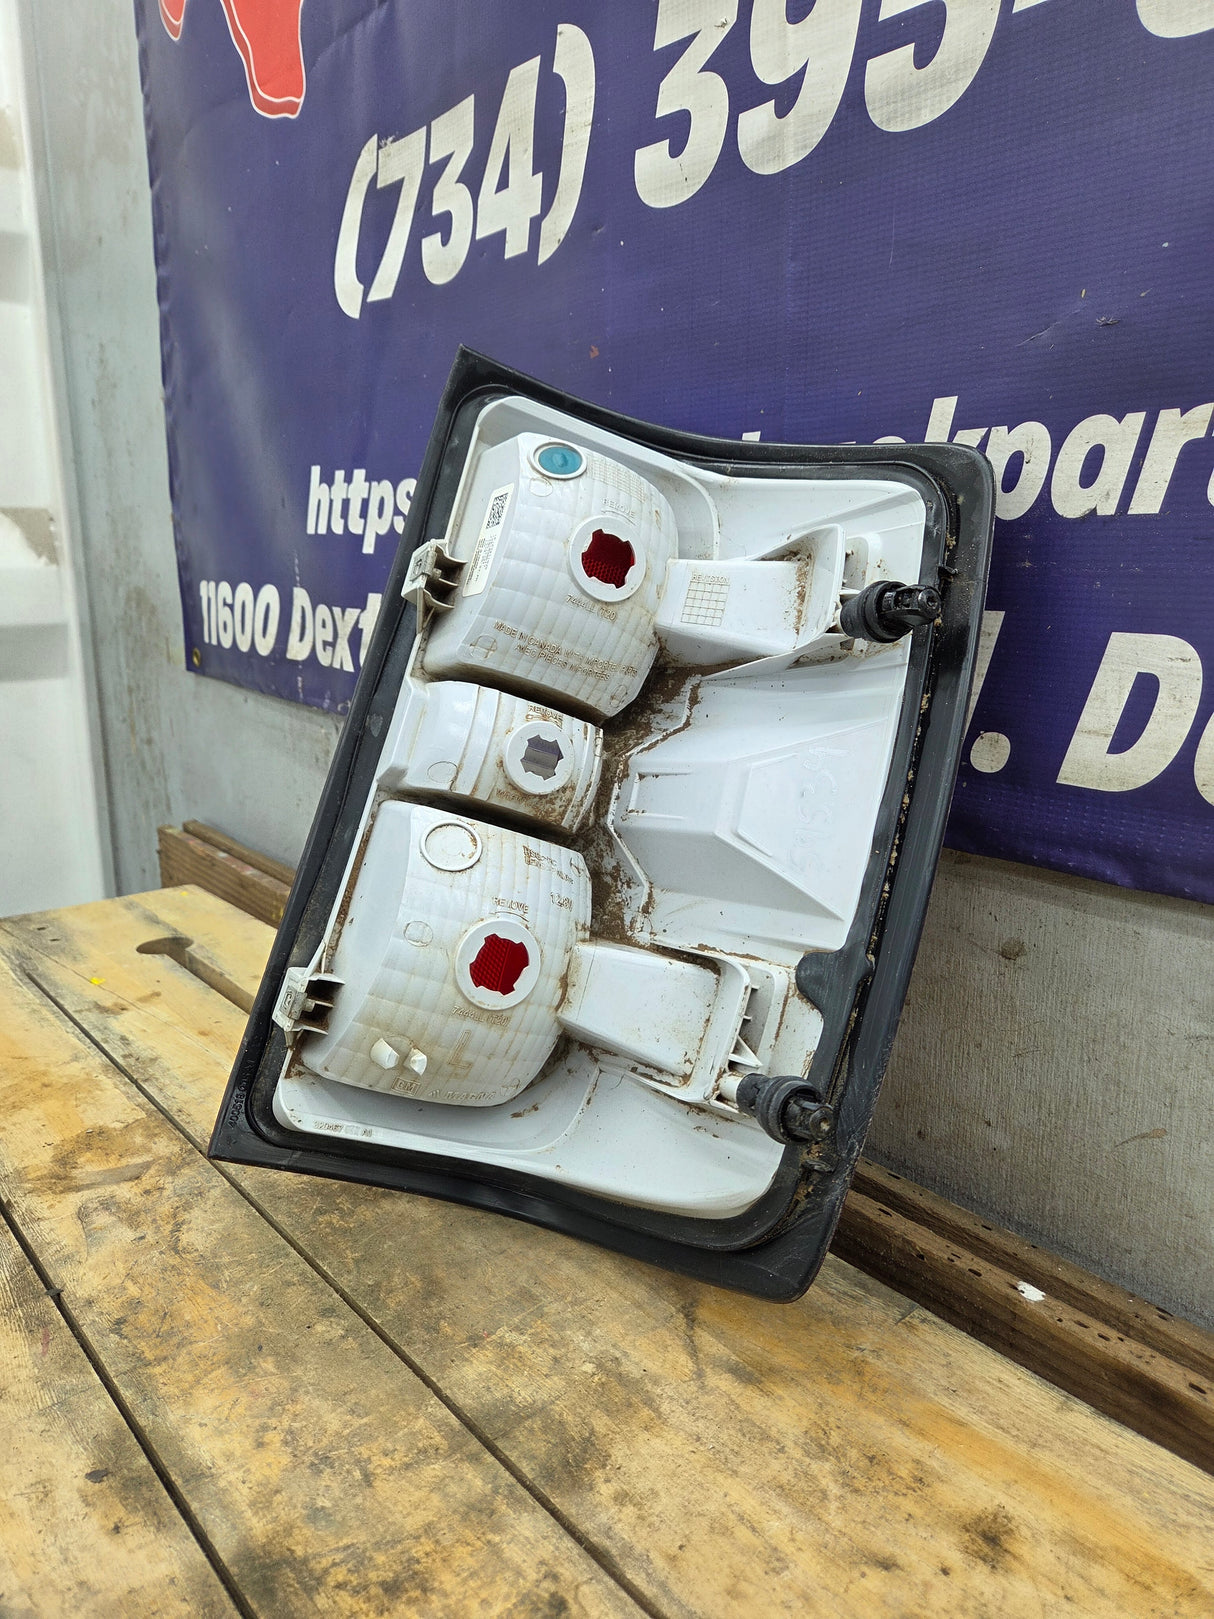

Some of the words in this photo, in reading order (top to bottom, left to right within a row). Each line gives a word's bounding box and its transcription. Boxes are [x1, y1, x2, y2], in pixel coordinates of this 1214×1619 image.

[333, 23, 596, 320] (734)
[199, 579, 280, 657] 11600
[1055, 631, 1214, 807] D
[494, 621, 518, 639] MADE
[527, 636, 561, 655] CANADA
[492, 896, 529, 914] REMOVE
